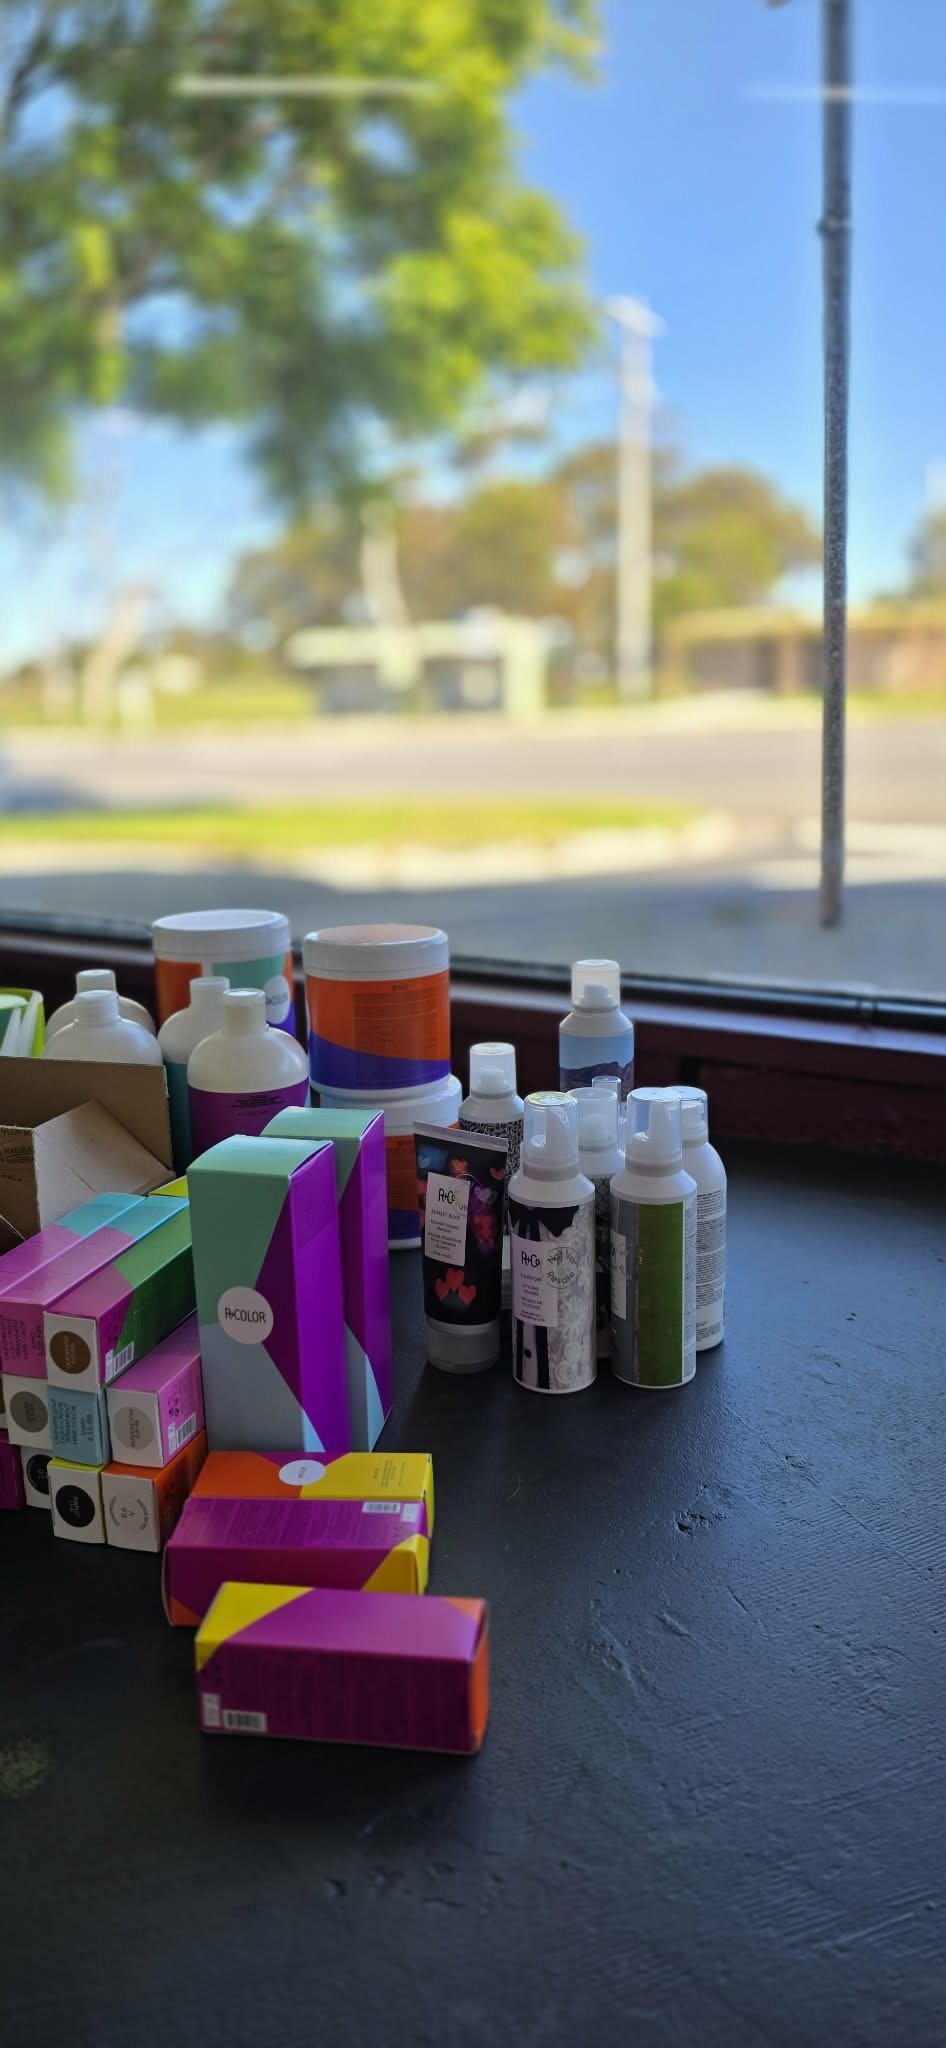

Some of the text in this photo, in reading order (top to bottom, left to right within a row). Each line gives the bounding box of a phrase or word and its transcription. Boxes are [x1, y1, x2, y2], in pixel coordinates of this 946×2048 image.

[438, 1188, 457, 1204] R+Co
[521, 1251, 540, 1268] R+Co
[546, 1271, 576, 1284] Resale
[225, 1307, 266, 1324] R+COLOR
